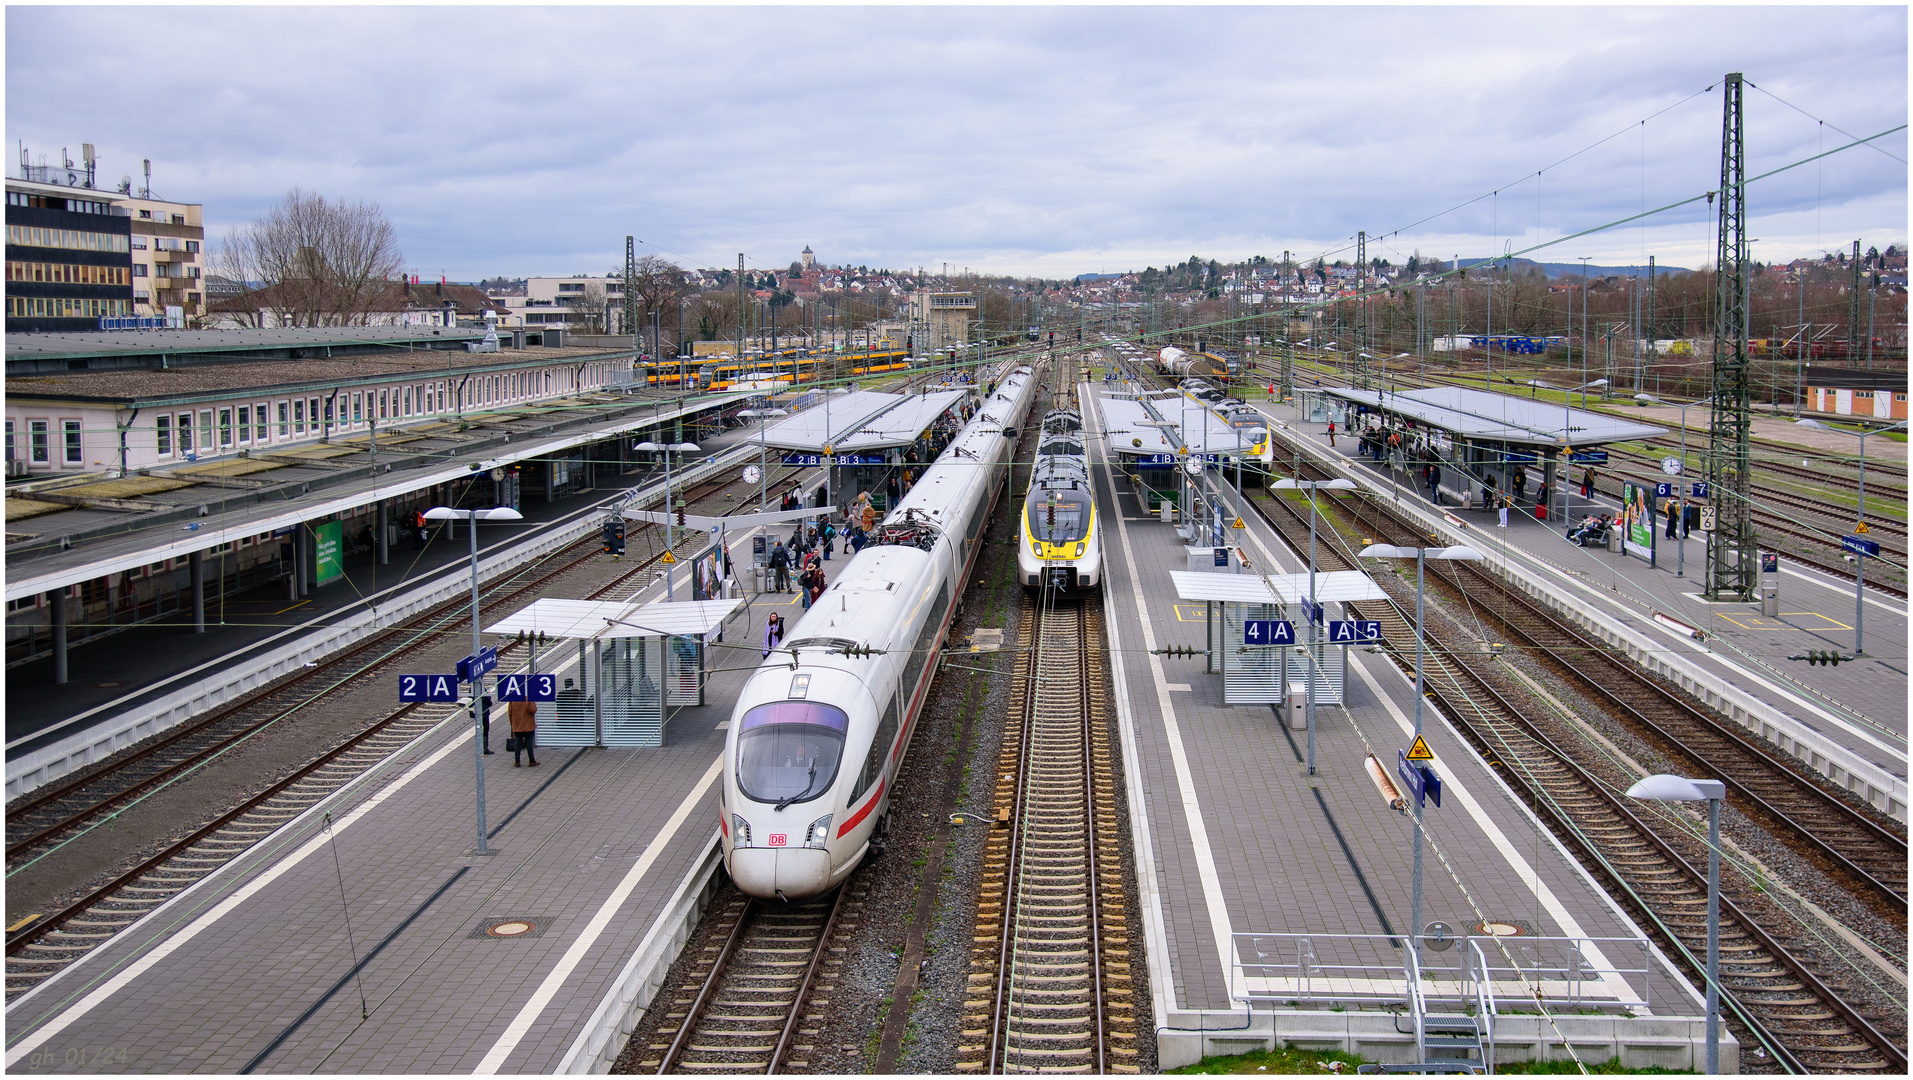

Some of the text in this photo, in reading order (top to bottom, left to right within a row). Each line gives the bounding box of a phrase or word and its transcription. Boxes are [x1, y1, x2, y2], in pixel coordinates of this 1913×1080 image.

[798, 455, 804, 464] 2
[811, 455, 817, 464] B
[840, 455, 847, 464] B
[853, 455, 859, 464] 3
[1152, 455, 1158, 463] 4
[1164, 455, 1171, 463] B
[1208, 455, 1215, 463] 5
[1658, 484, 1666, 495] 6
[1698, 483, 1706, 494] 7
[1701, 507, 1715, 518] 52
[1704, 518, 1712, 528] 6
[1247, 622, 1289, 640] 4 A
[1336, 622, 1378, 640] A 5
[403, 676, 450, 696] 2 A
[505, 676, 552, 697] A 3
[771, 835, 785, 844] DB
